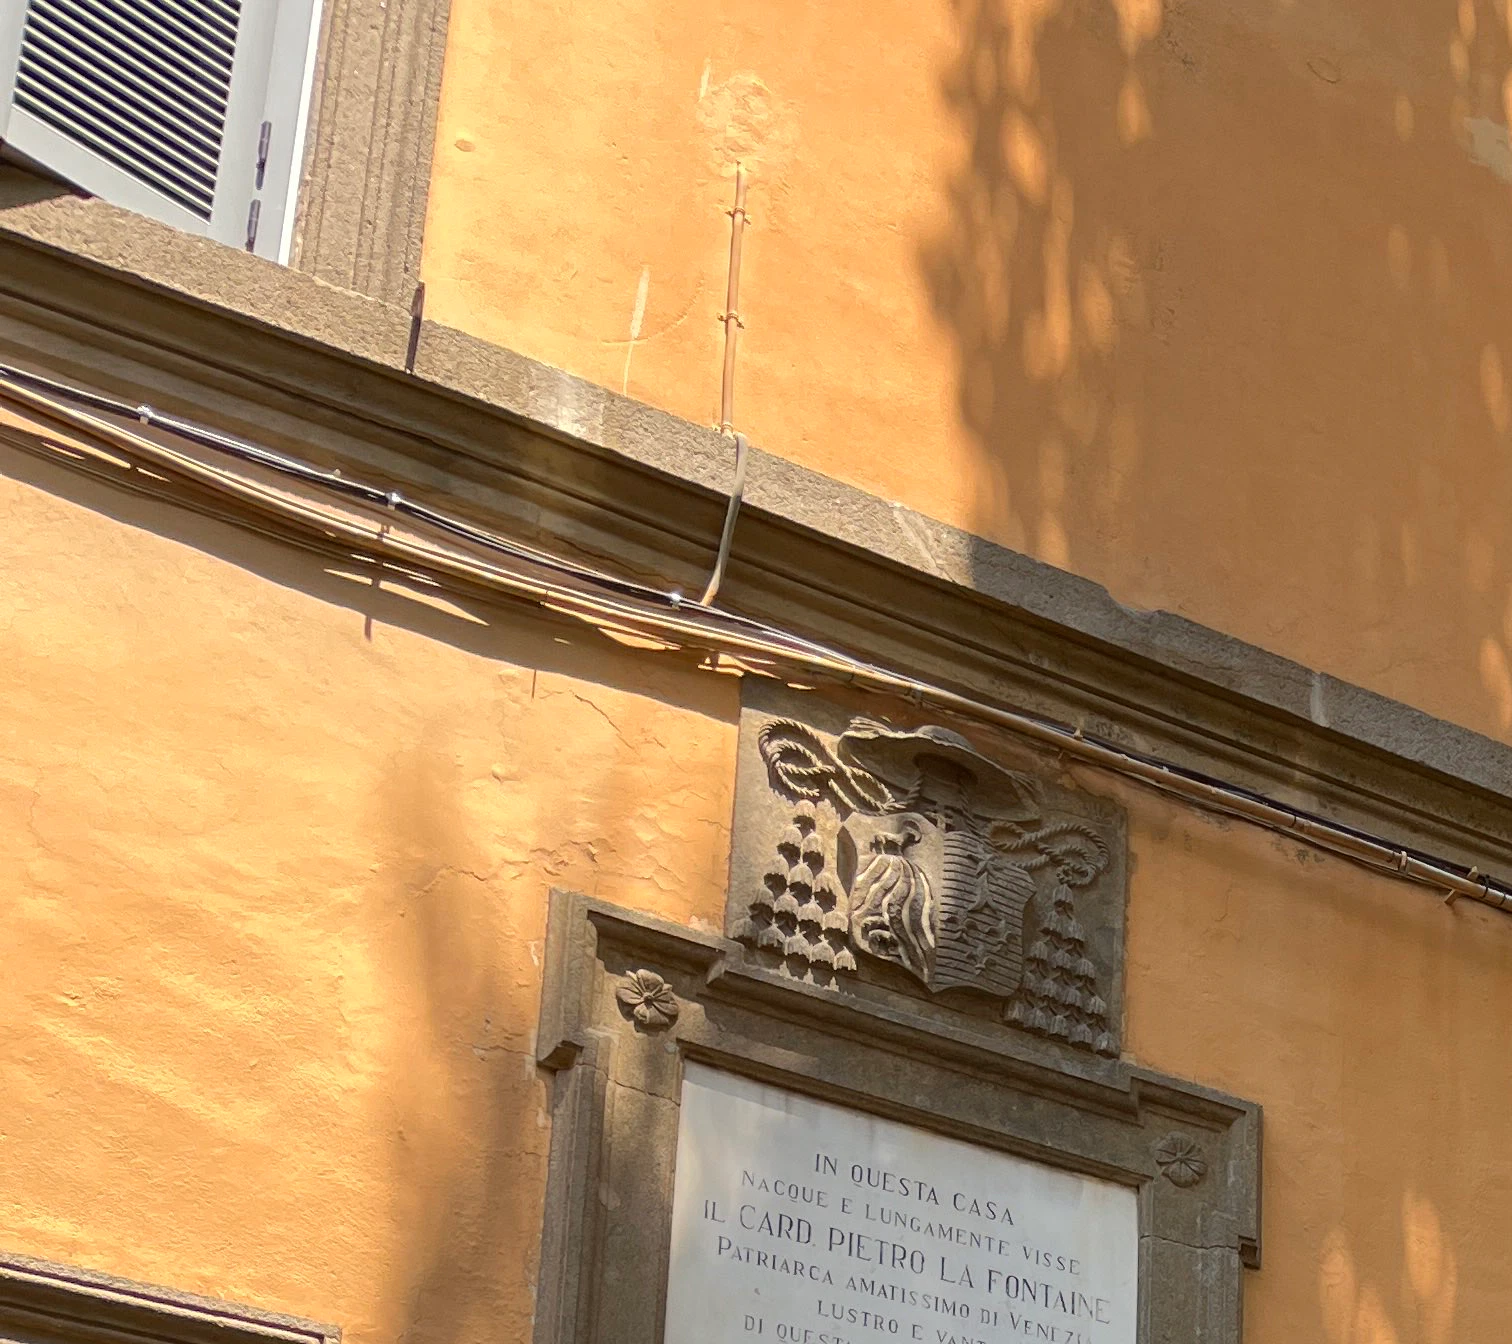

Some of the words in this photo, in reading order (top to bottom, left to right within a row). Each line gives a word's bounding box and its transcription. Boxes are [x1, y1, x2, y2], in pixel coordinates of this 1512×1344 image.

[741, 1169, 829, 1208] NACQUE
[840, 1197, 853, 1215] E
[865, 1203, 1011, 1257] LUNGAMENTE
[1022, 1244, 1081, 1276] VISSE
[815, 1153, 839, 1176] IN
[850, 1164, 940, 1206] QUESTA
[952, 1192, 1015, 1226] CASA
[703, 1199, 726, 1224] IL
[739, 1204, 817, 1247] CARD.
[828, 1226, 925, 1275] PIETRO
[940, 1256, 975, 1290] LA
[987, 1268, 1112, 1325] FONTAINE
[717, 1235, 834, 1286] PATRIARCA
[845, 1276, 971, 1319] AMATISSIMO
[980, 1307, 998, 1327] DI
[743, 1313, 764, 1335] DI
[817, 1299, 899, 1334] LUSTRO
[911, 1323, 924, 1341] E
